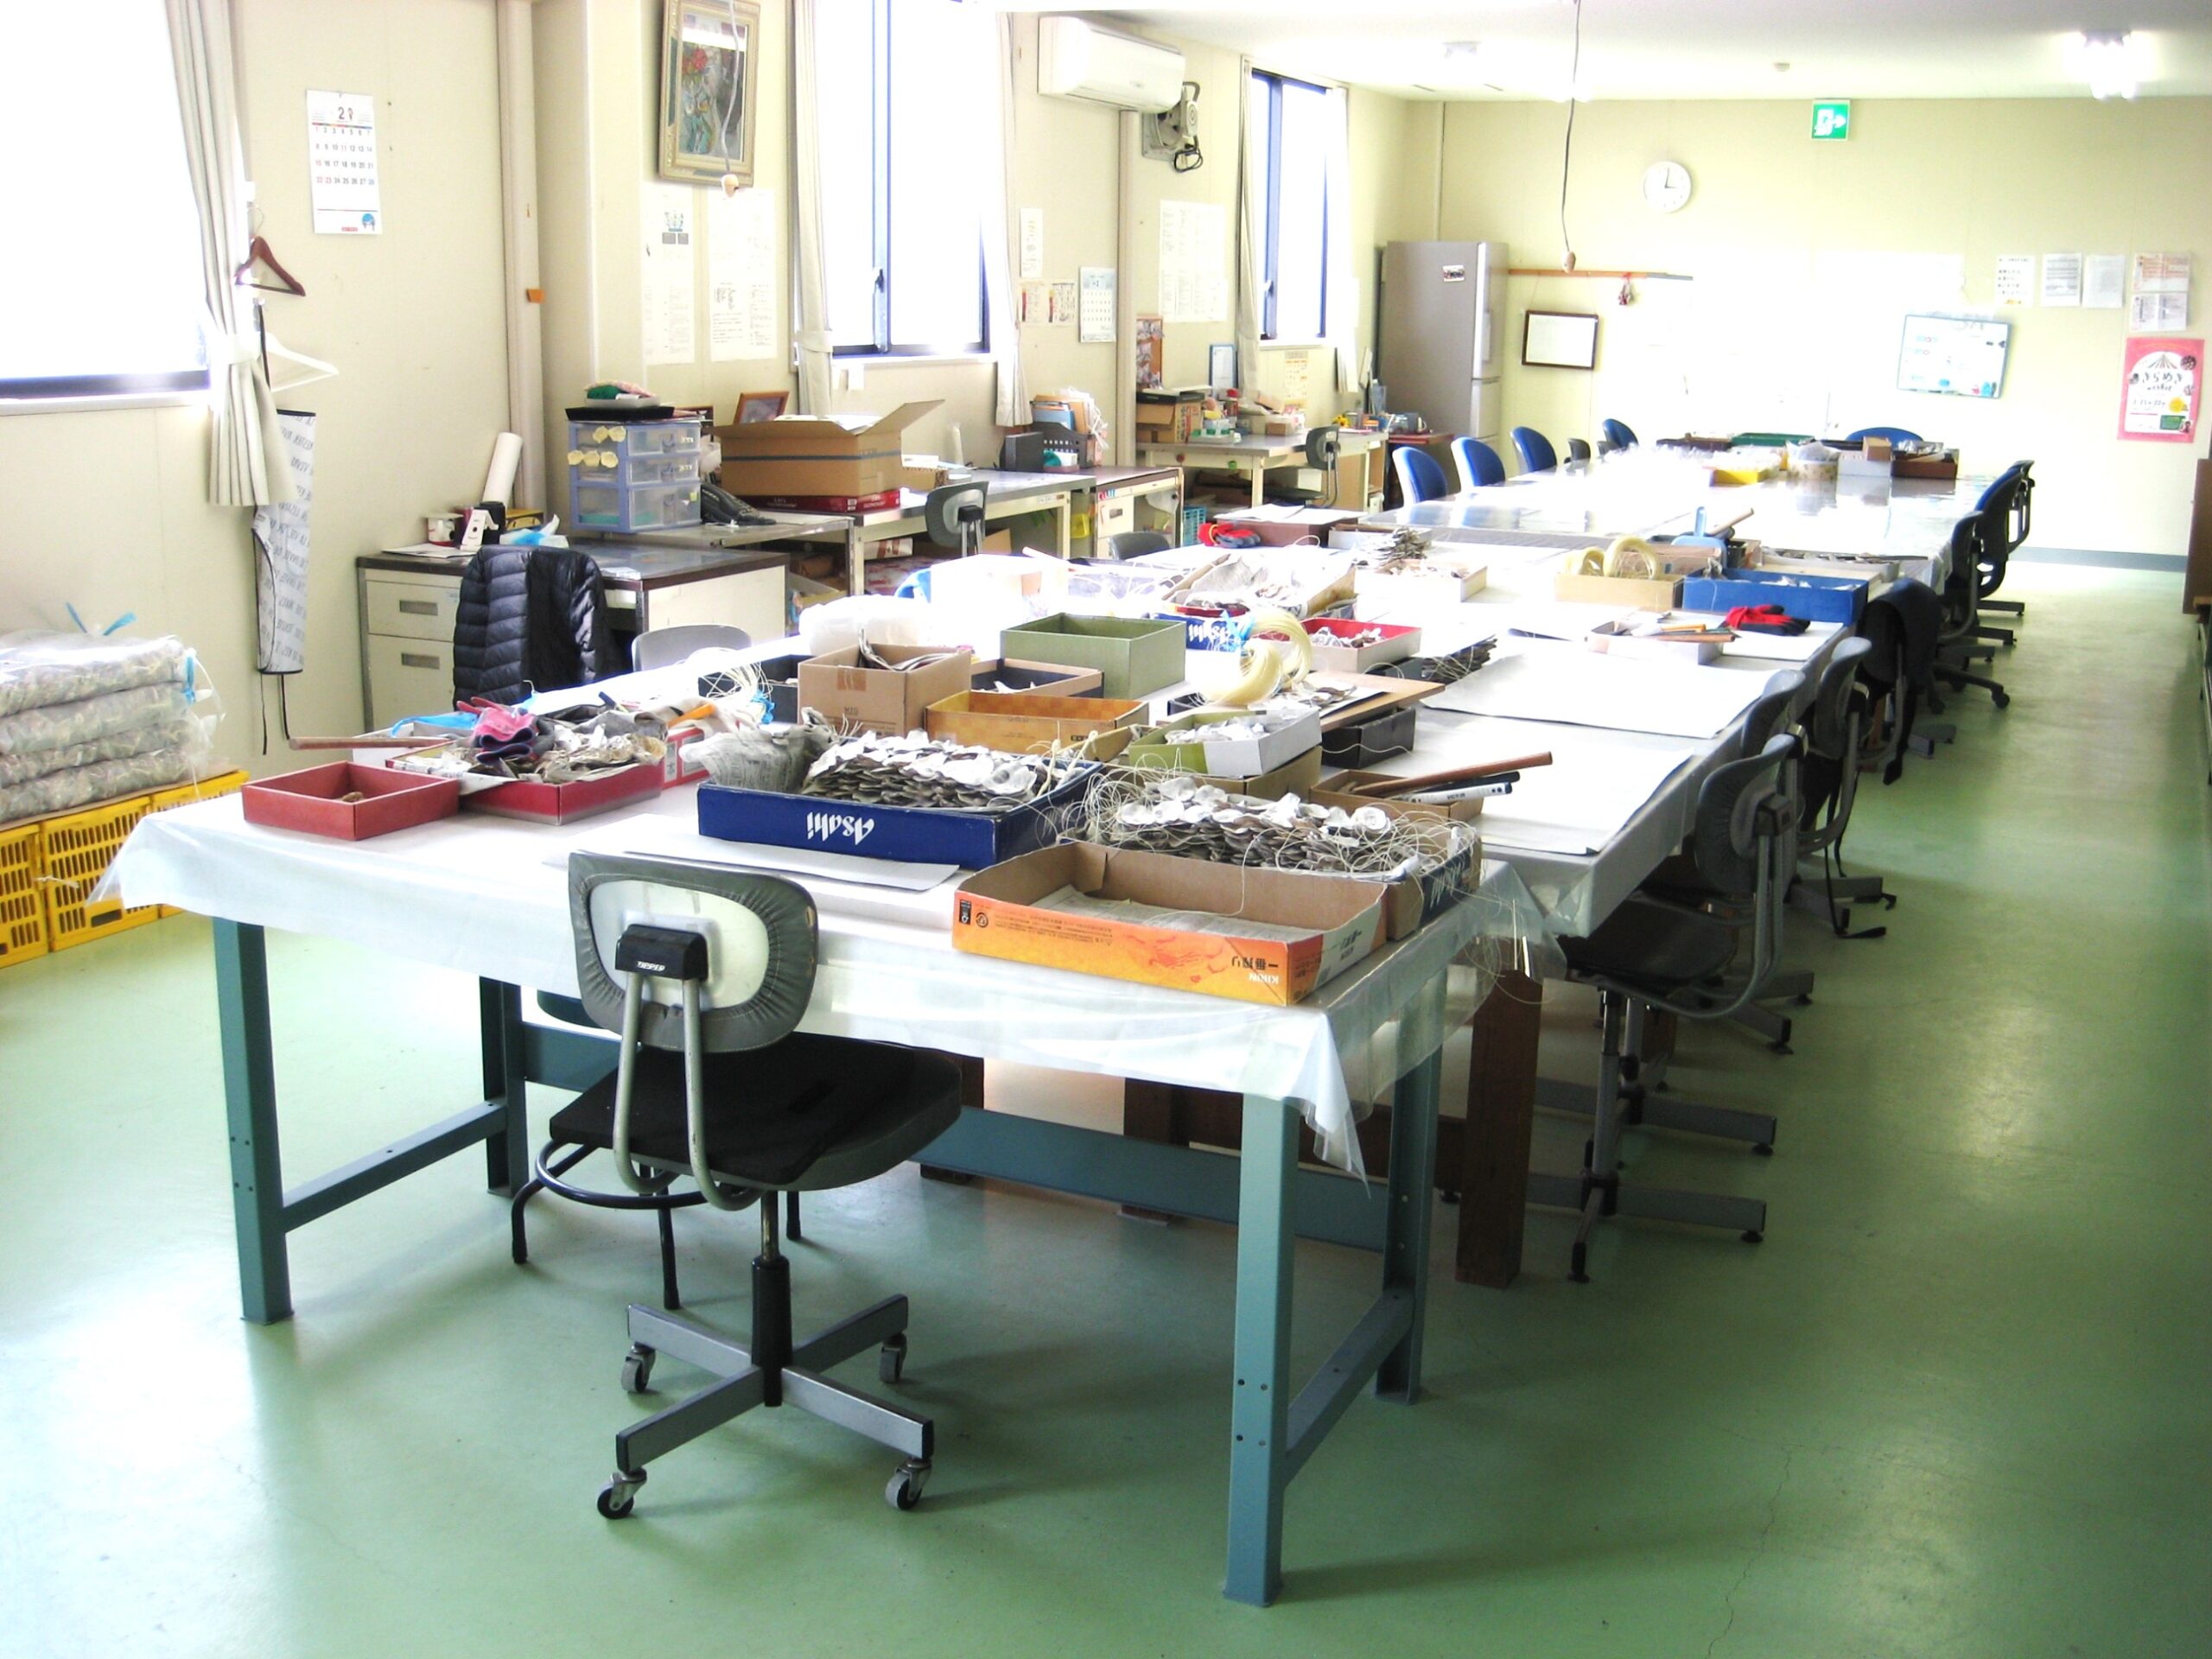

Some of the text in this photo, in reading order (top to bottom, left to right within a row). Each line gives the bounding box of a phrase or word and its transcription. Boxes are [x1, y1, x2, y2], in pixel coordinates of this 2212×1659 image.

[337, 106, 346, 120] 2
[806, 811, 875, 846] Asahi
[1231, 956, 1279, 970] 一番搾り
[1248, 973, 1280, 985] KIRIN
